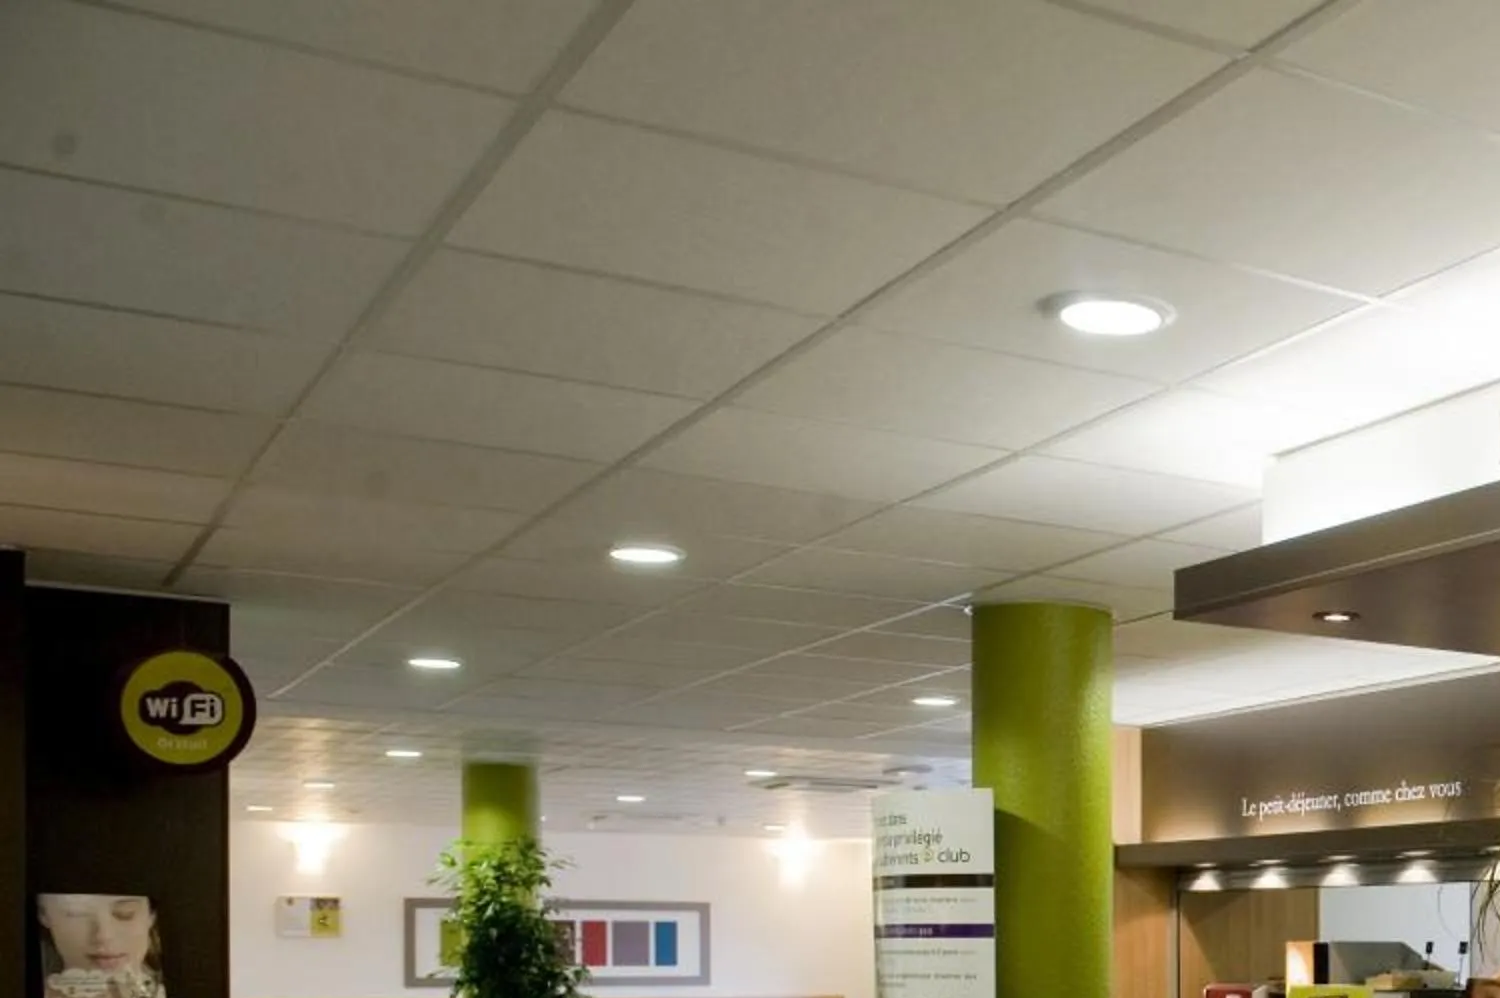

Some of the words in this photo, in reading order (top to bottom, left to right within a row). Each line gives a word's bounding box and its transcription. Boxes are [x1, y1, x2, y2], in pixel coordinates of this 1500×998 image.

[1241, 797, 1257, 818] Le
[1344, 788, 1392, 807] comme
[1395, 779, 1425, 800] chez
[1428, 780, 1462, 799] vous
[937, 847, 971, 863] club
